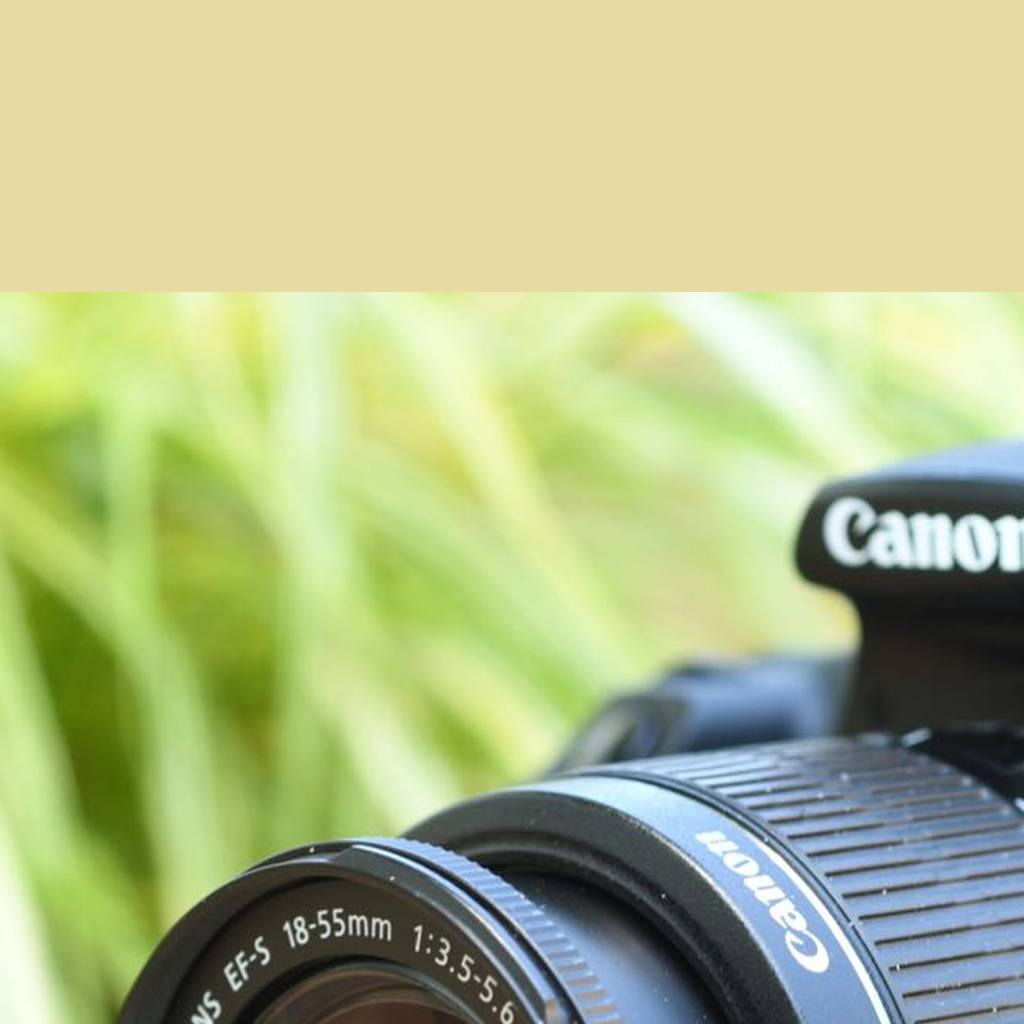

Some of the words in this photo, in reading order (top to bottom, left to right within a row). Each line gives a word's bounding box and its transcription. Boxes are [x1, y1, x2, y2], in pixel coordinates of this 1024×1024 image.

[222, 935, 272, 993] EF-S
[282, 907, 393, 950] 18-55mm
[694, 830, 830, 974] Canon
